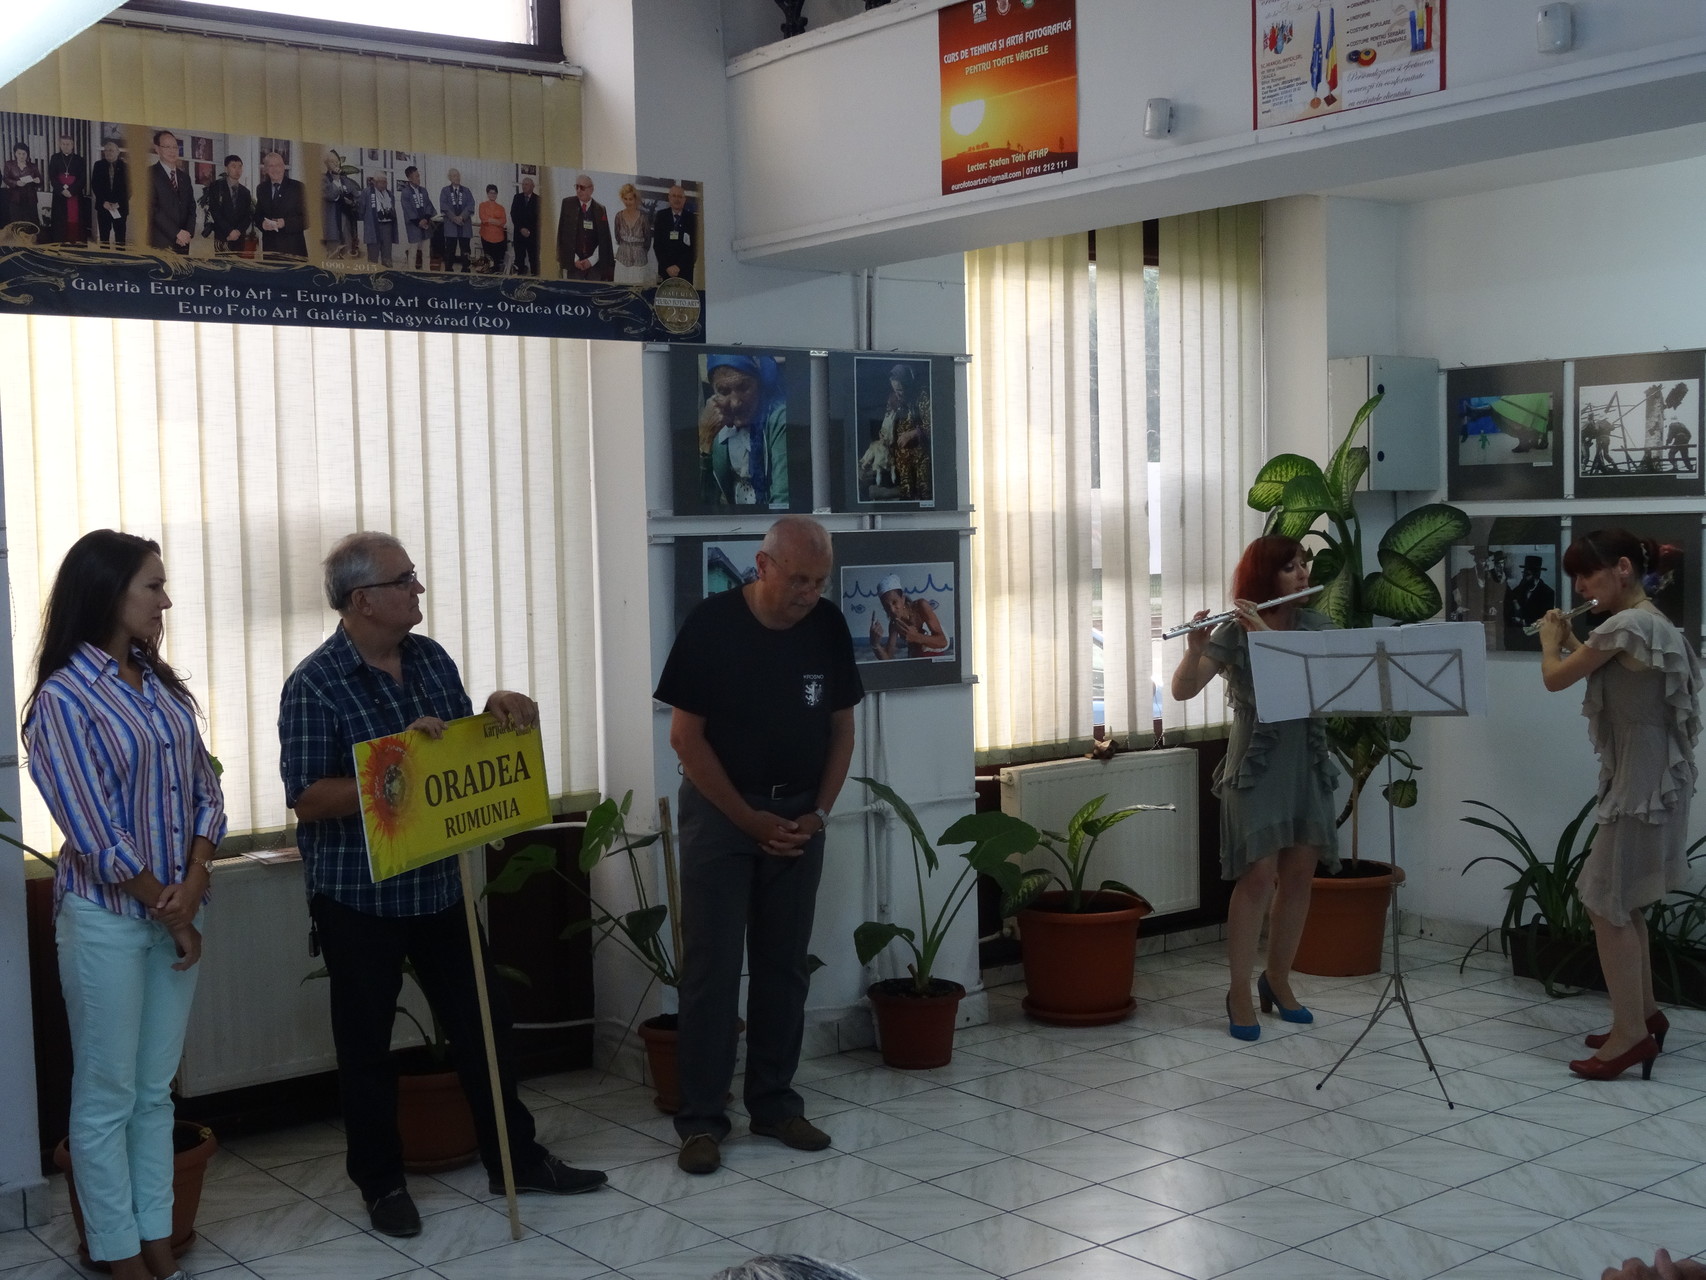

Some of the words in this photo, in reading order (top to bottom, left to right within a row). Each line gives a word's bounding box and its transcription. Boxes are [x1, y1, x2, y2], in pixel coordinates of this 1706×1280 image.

[944, 52, 959, 64] CURS
[960, 49, 969, 60] DE
[966, 60, 991, 76] PENTRU
[993, 54, 1014, 68] TOATE
[967, 162, 988, 172] Lector:
[1012, 154, 1026, 164] Tóth
[1028, 148, 1048, 160] AFIAP
[1026, 166, 1041, 176] 0741
[1043, 162, 1054, 172] 212
[1056, 160, 1068, 169] 111
[72, 278, 140, 294] Galeria
[150, 282, 195, 296] Euro
[200, 284, 240, 298] Foto
[246, 288, 272, 300] Art
[297, 290, 338, 304] Euro
[342, 292, 390, 306] Photo
[394, 296, 419, 308] Art
[427, 297, 484, 314] Gallery
[497, 301, 552, 314] Oradea
[555, 304, 592, 318] (RO)
[178, 302, 222, 315] Euro
[227, 304, 267, 318] Foto
[272, 306, 298, 319] Art
[306, 308, 367, 322] Galéria
[382, 312, 468, 328] Nagyvárad
[472, 316, 510, 329] (RO)
[424, 750, 531, 808] ORADEA
[444, 797, 520, 840] RUMUNIA
